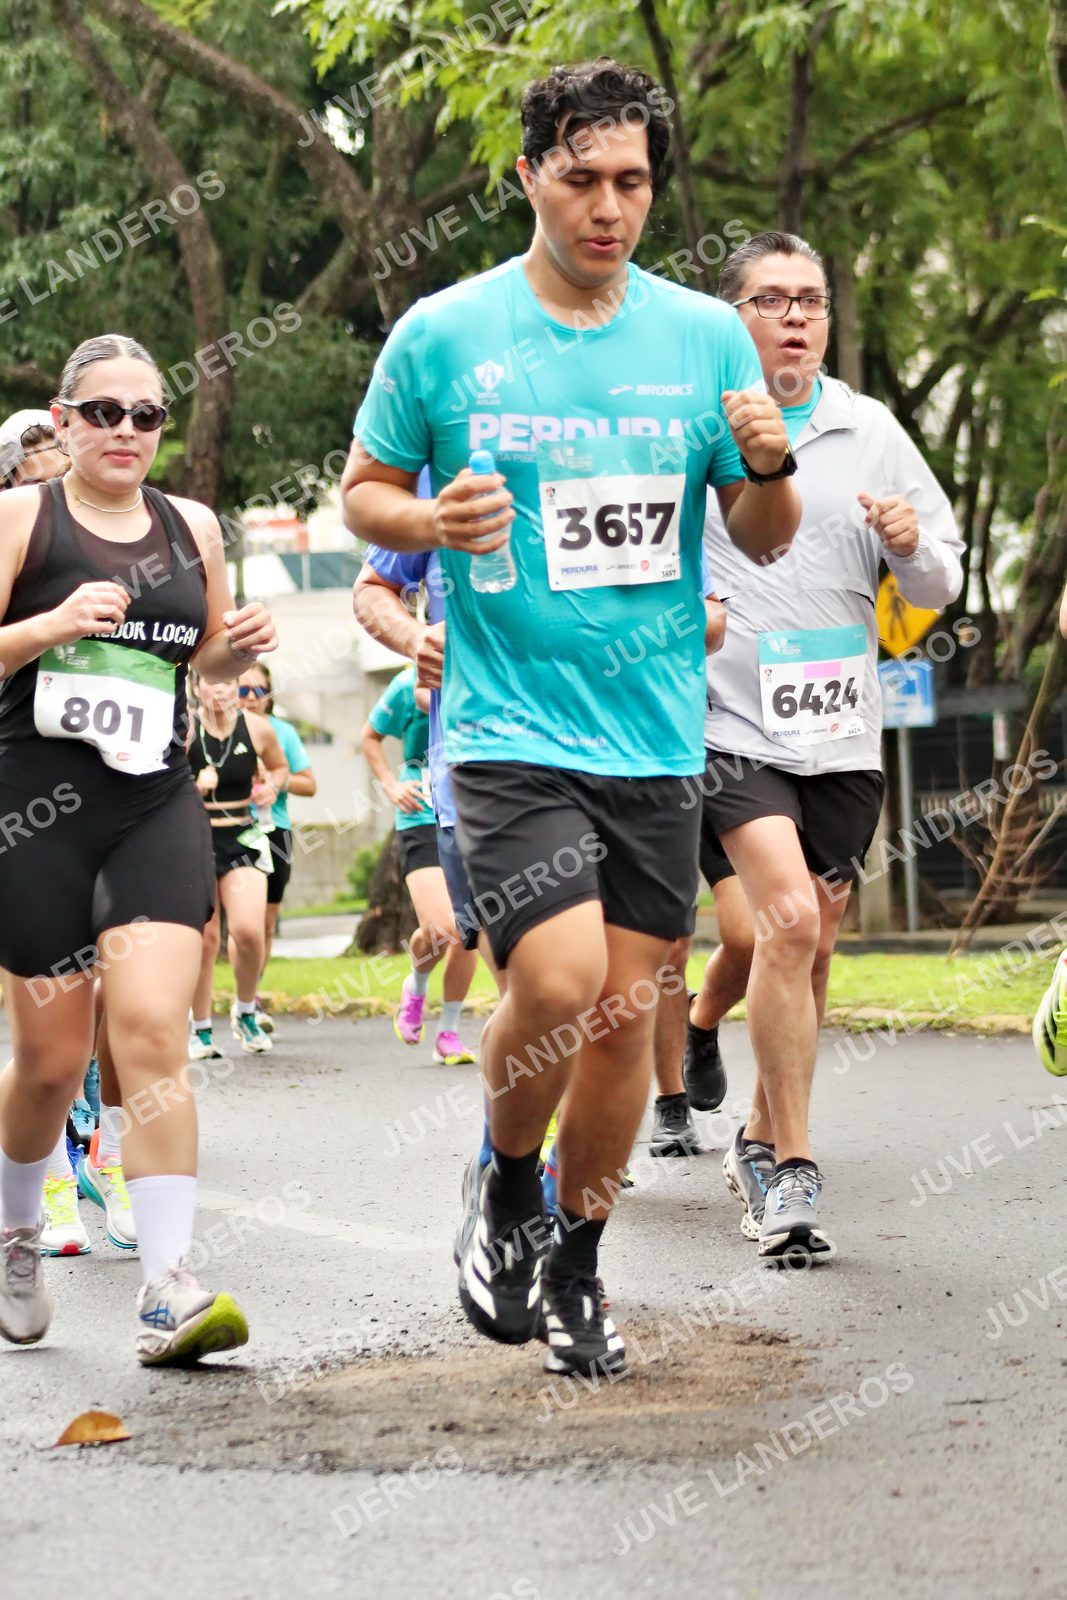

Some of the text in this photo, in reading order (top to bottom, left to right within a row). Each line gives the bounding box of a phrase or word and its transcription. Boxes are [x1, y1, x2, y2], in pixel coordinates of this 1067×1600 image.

[636, 383, 693, 397] BROOKS
[557, 502, 676, 551] 3657
[561, 564, 598, 575] PERDURA
[772, 677, 858, 719] 6424
[60, 697, 144, 743] 801
